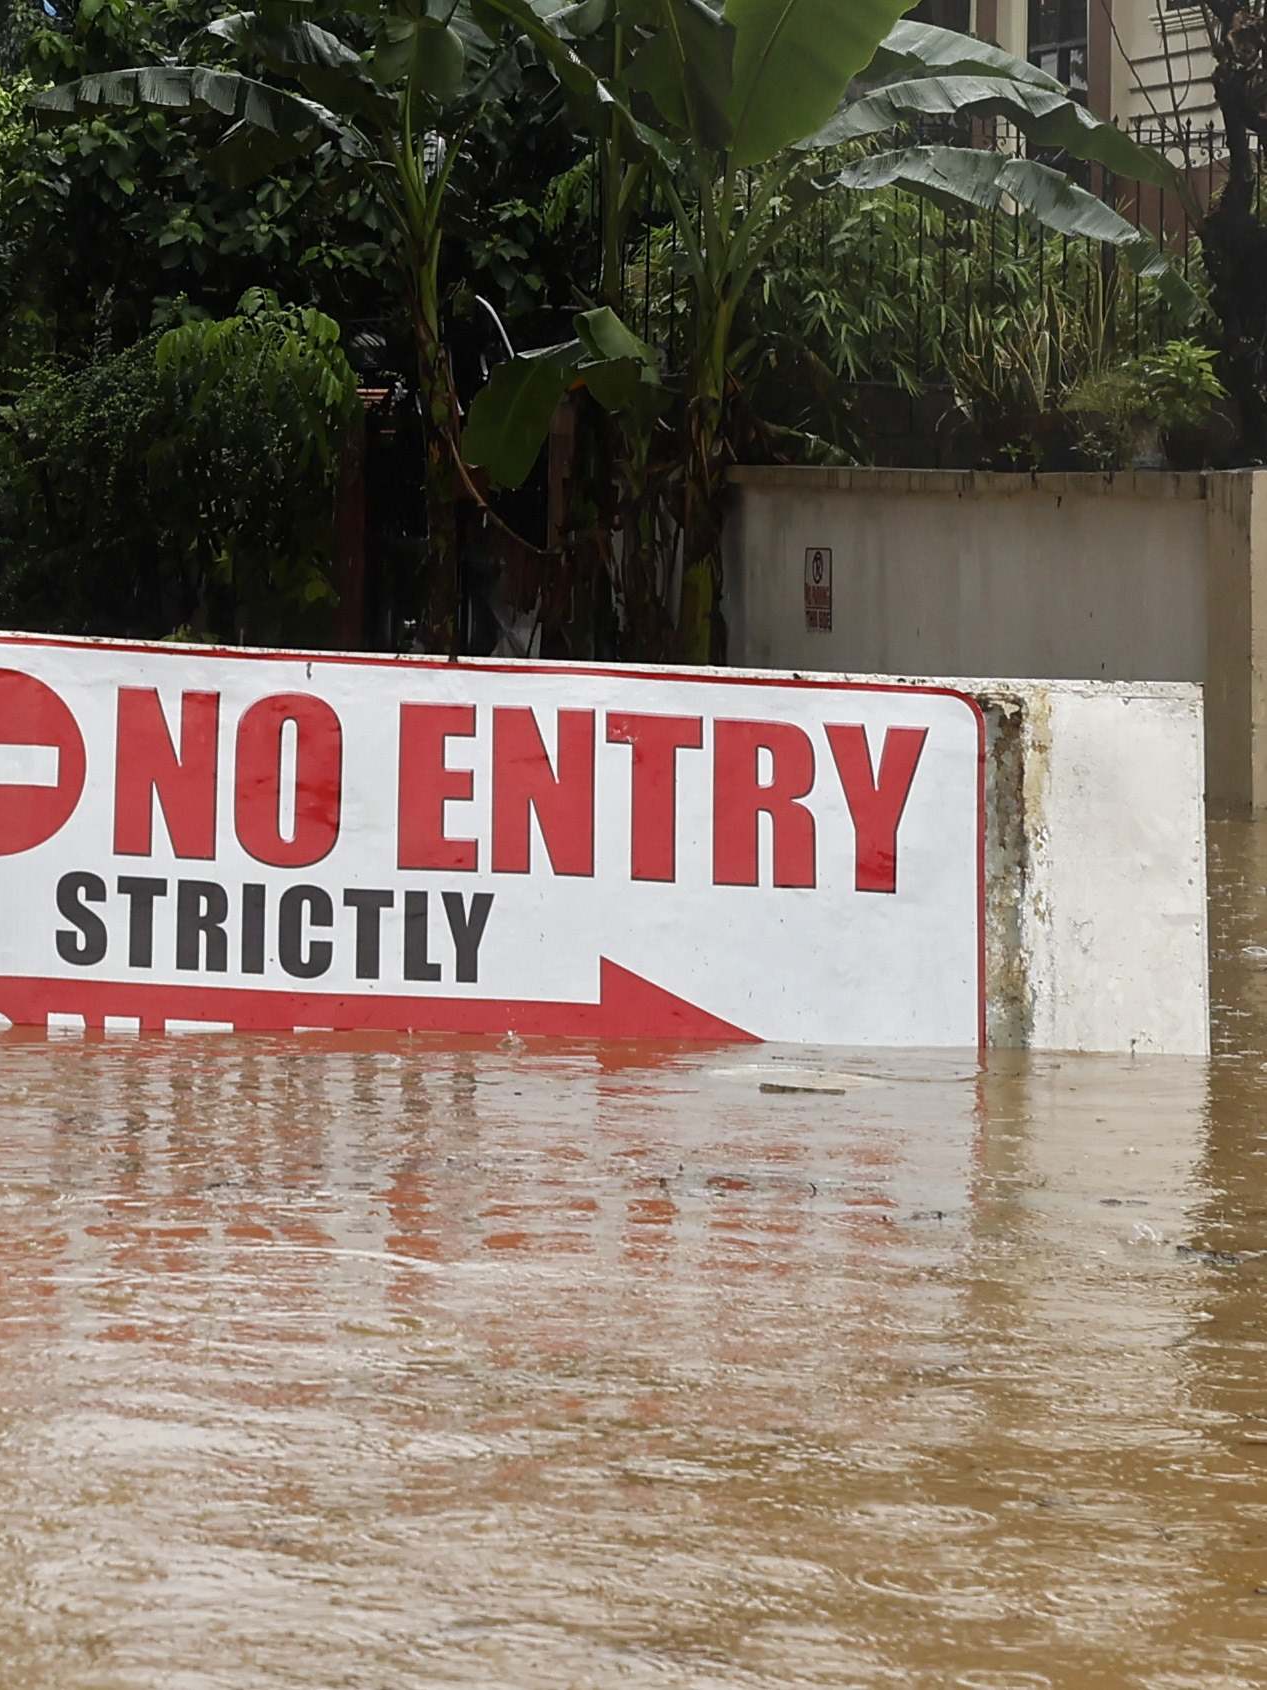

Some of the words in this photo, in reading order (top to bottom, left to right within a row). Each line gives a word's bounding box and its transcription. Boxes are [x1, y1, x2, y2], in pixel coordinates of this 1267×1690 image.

[114, 685, 343, 868] NO
[397, 701, 931, 895] ENTRY
[55, 871, 496, 984] STRICTLY
